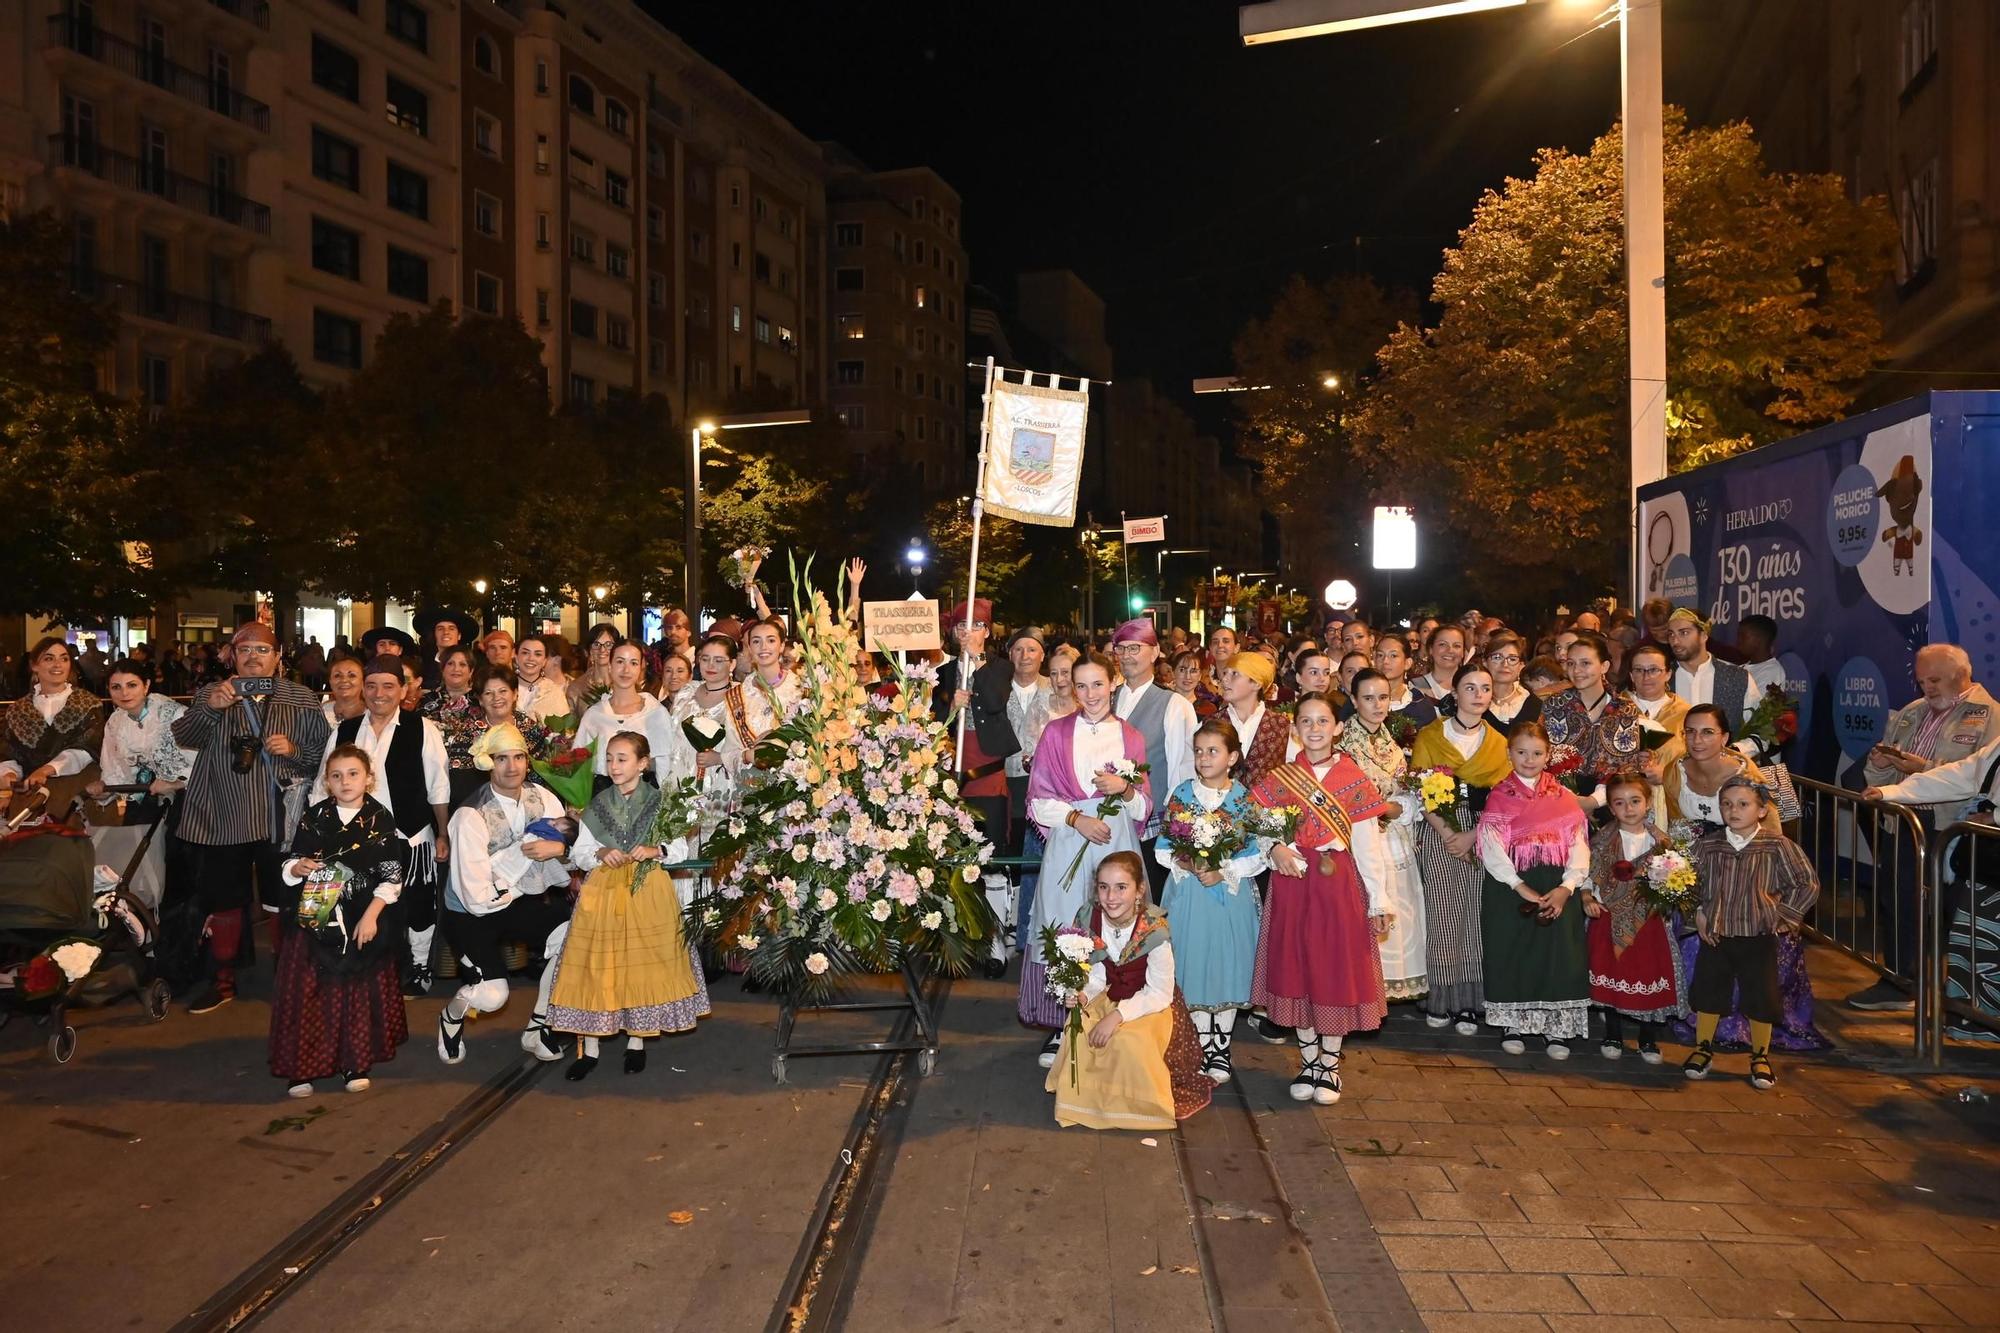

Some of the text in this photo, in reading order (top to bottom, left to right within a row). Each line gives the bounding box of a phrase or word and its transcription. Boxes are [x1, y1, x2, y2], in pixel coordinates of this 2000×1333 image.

[1833, 486, 1873, 508] PELUCHE
[1726, 502, 1778, 531] HERALDO
[1835, 502, 1871, 520] MORICO
[1838, 525, 1867, 544] 9,95€
[1718, 543, 1801, 585] 130 años
[1711, 581, 1806, 625] de Pilares
[873, 623, 934, 635] LOSCOS
[1784, 680, 1807, 692] OCHE
[1845, 677, 1874, 691] LIBRO
[1840, 693, 1880, 708] LA JOTA
[1845, 714, 1874, 732] 9,95€
